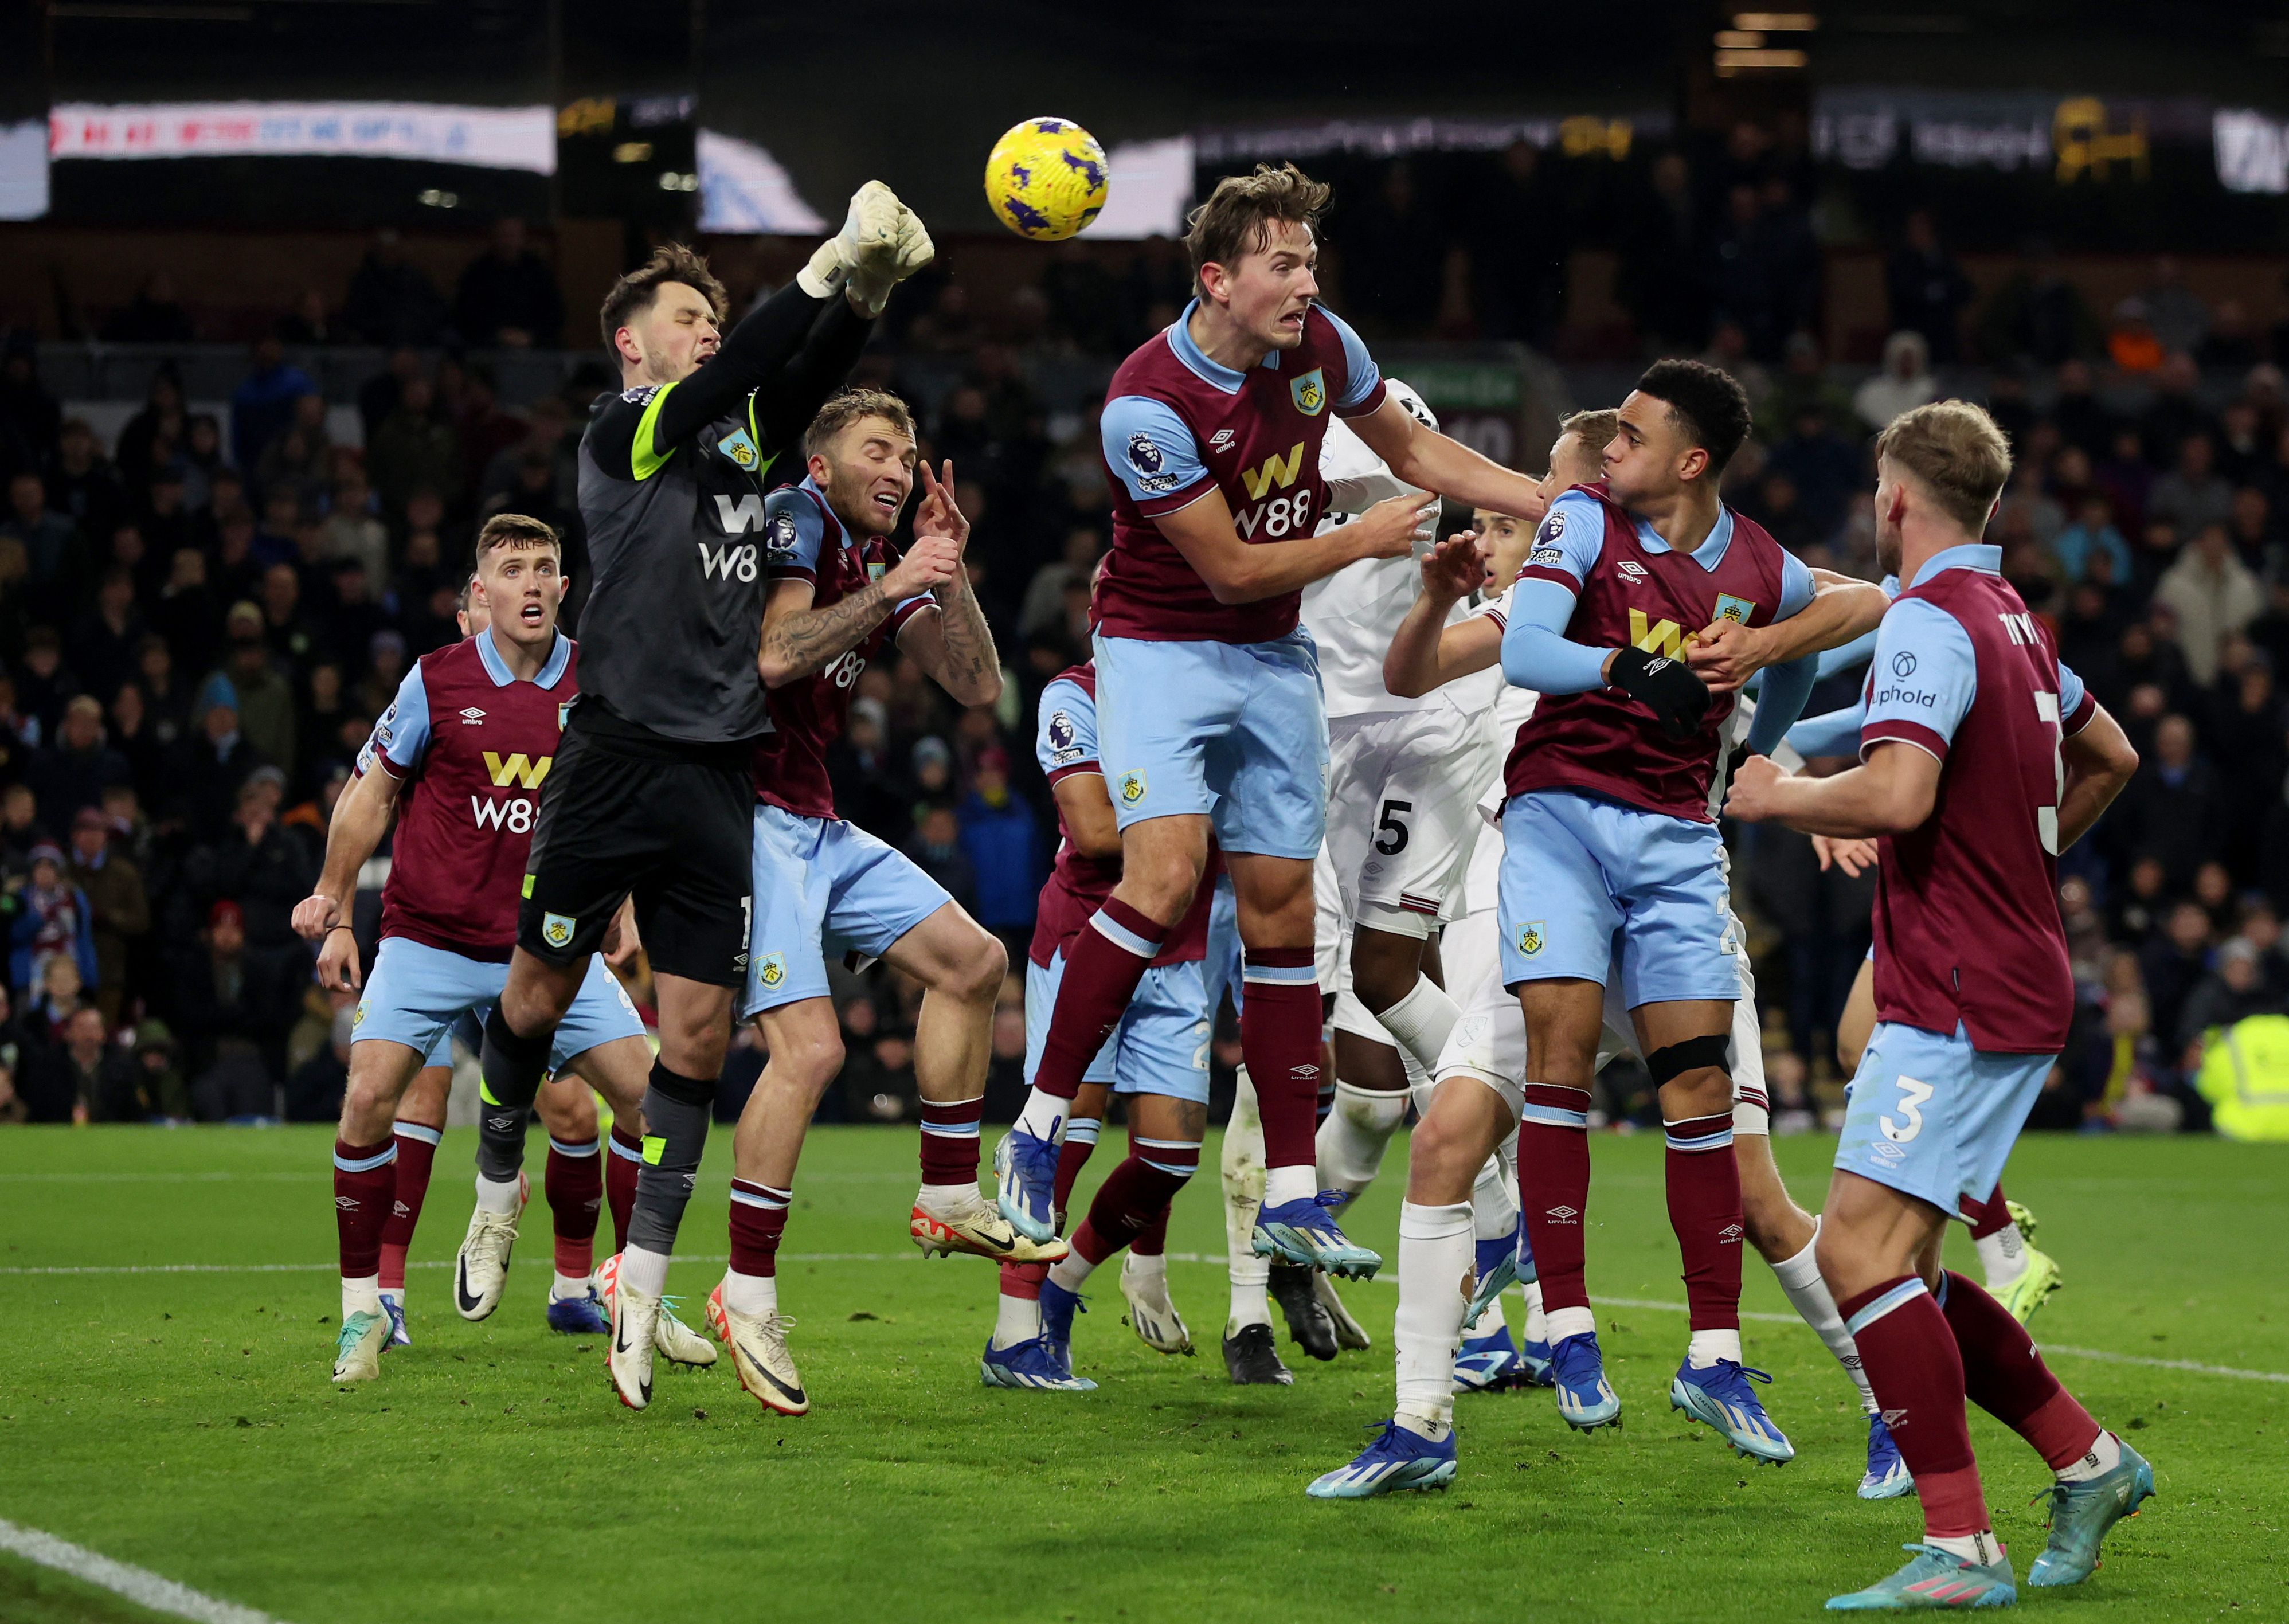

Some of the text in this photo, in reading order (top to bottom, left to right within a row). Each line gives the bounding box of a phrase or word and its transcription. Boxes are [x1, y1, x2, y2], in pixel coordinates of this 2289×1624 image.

[1215, 440, 1235, 453] umbro
[1241, 441, 1305, 502] W
[1537, 549, 1558, 558] room
[1618, 572, 1642, 585] umbro
[1872, 684, 1937, 709] uphold
[482, 751, 554, 790] W
[1369, 799, 1412, 856] 5
[1878, 1074, 1935, 1144] 3
